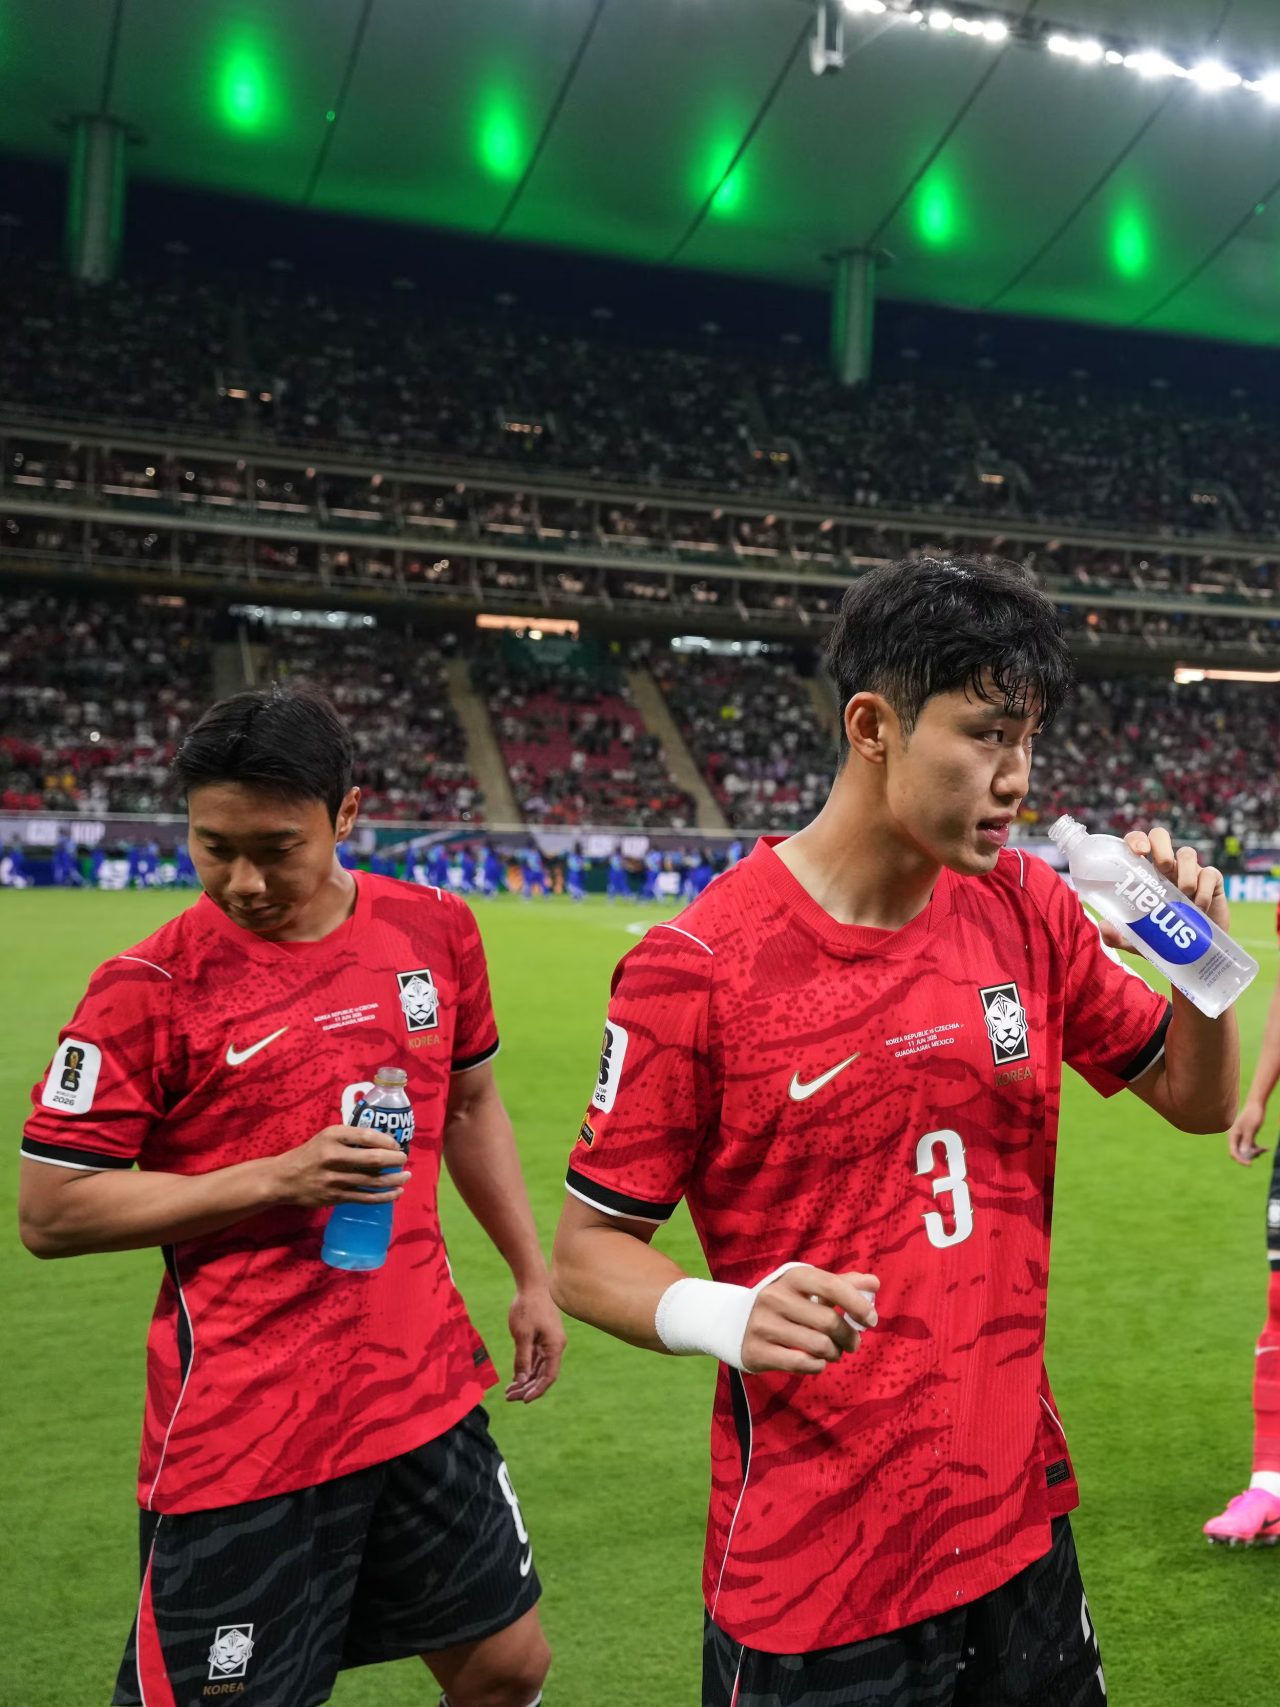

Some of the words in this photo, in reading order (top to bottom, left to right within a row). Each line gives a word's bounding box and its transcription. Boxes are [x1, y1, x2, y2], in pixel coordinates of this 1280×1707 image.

[1133, 865, 1168, 898] water
[1114, 871, 1197, 949] smart
[408, 1035, 440, 1048] KOREA
[885, 1036, 904, 1046] KOREA
[904, 1029, 929, 1041] REPUBLIC
[934, 1023, 960, 1033] CZECHIA
[916, 1036, 926, 1045] JUN
[931, 1037, 955, 1047] MEXICO
[994, 1066, 1032, 1087] KOREA
[52, 1095, 75, 1106] 2026
[914, 1129, 975, 1249] 3
[203, 1682, 245, 1696] KOREA
